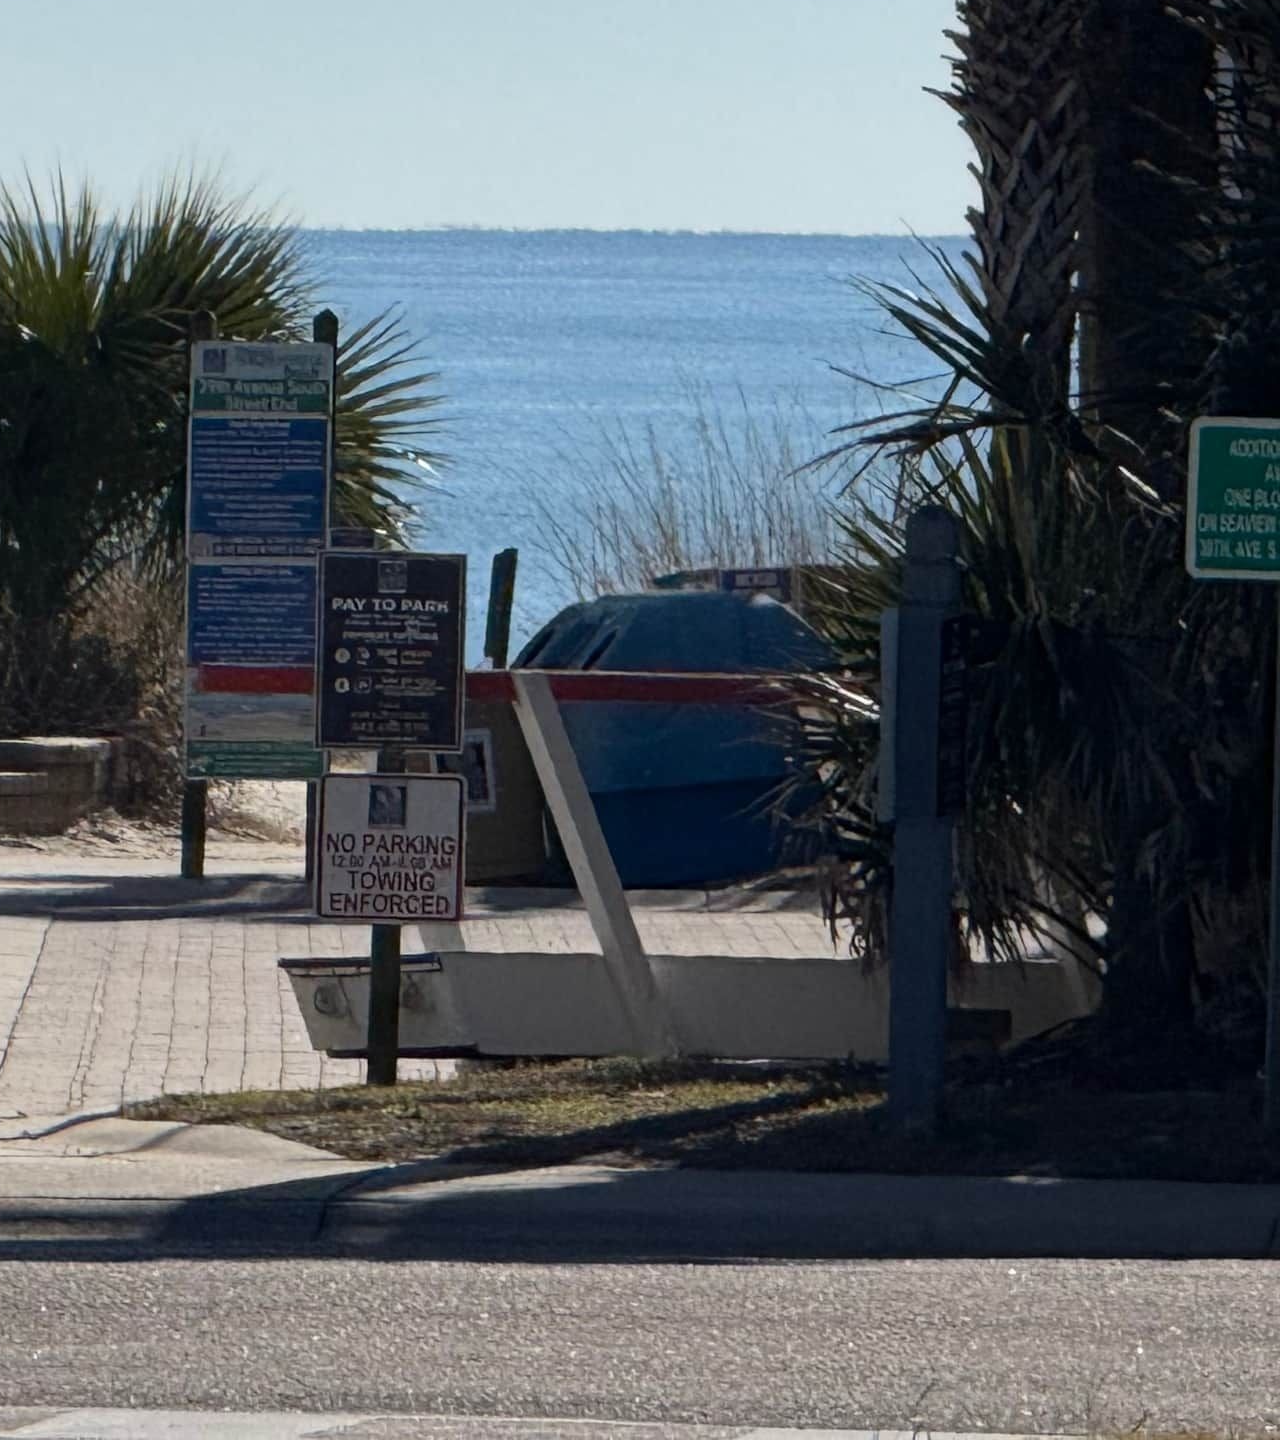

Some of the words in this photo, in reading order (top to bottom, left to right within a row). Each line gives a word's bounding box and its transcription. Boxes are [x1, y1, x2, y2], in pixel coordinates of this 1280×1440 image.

[331, 597, 366, 611] PAY
[372, 598, 396, 611] TO
[401, 599, 449, 613] PARK
[326, 833, 355, 853] NO
[363, 834, 456, 855] PARKING
[347, 870, 435, 892] TOWING
[329, 893, 450, 914] ENFORCED
